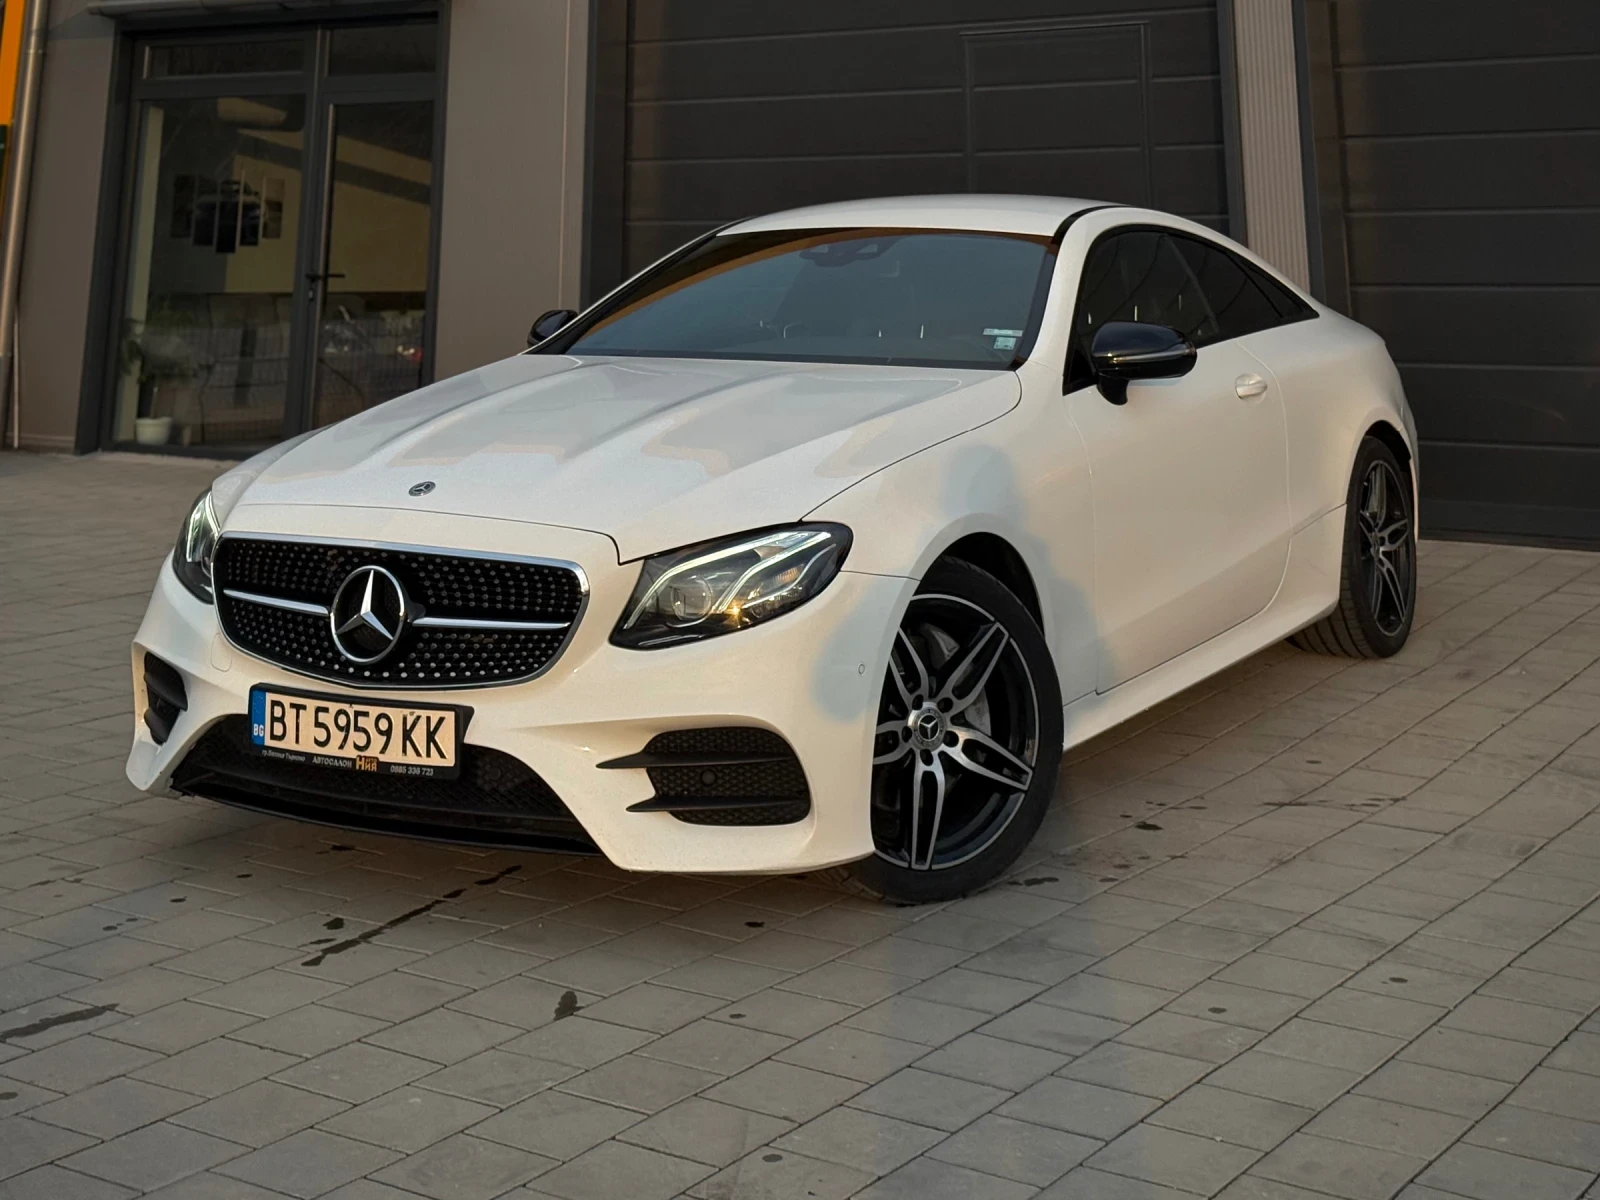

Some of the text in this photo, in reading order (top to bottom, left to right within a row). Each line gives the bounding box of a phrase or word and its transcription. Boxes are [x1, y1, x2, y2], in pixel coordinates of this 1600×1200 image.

[253, 723, 264, 737] BG
[270, 699, 447, 759] BT 5959 KK
